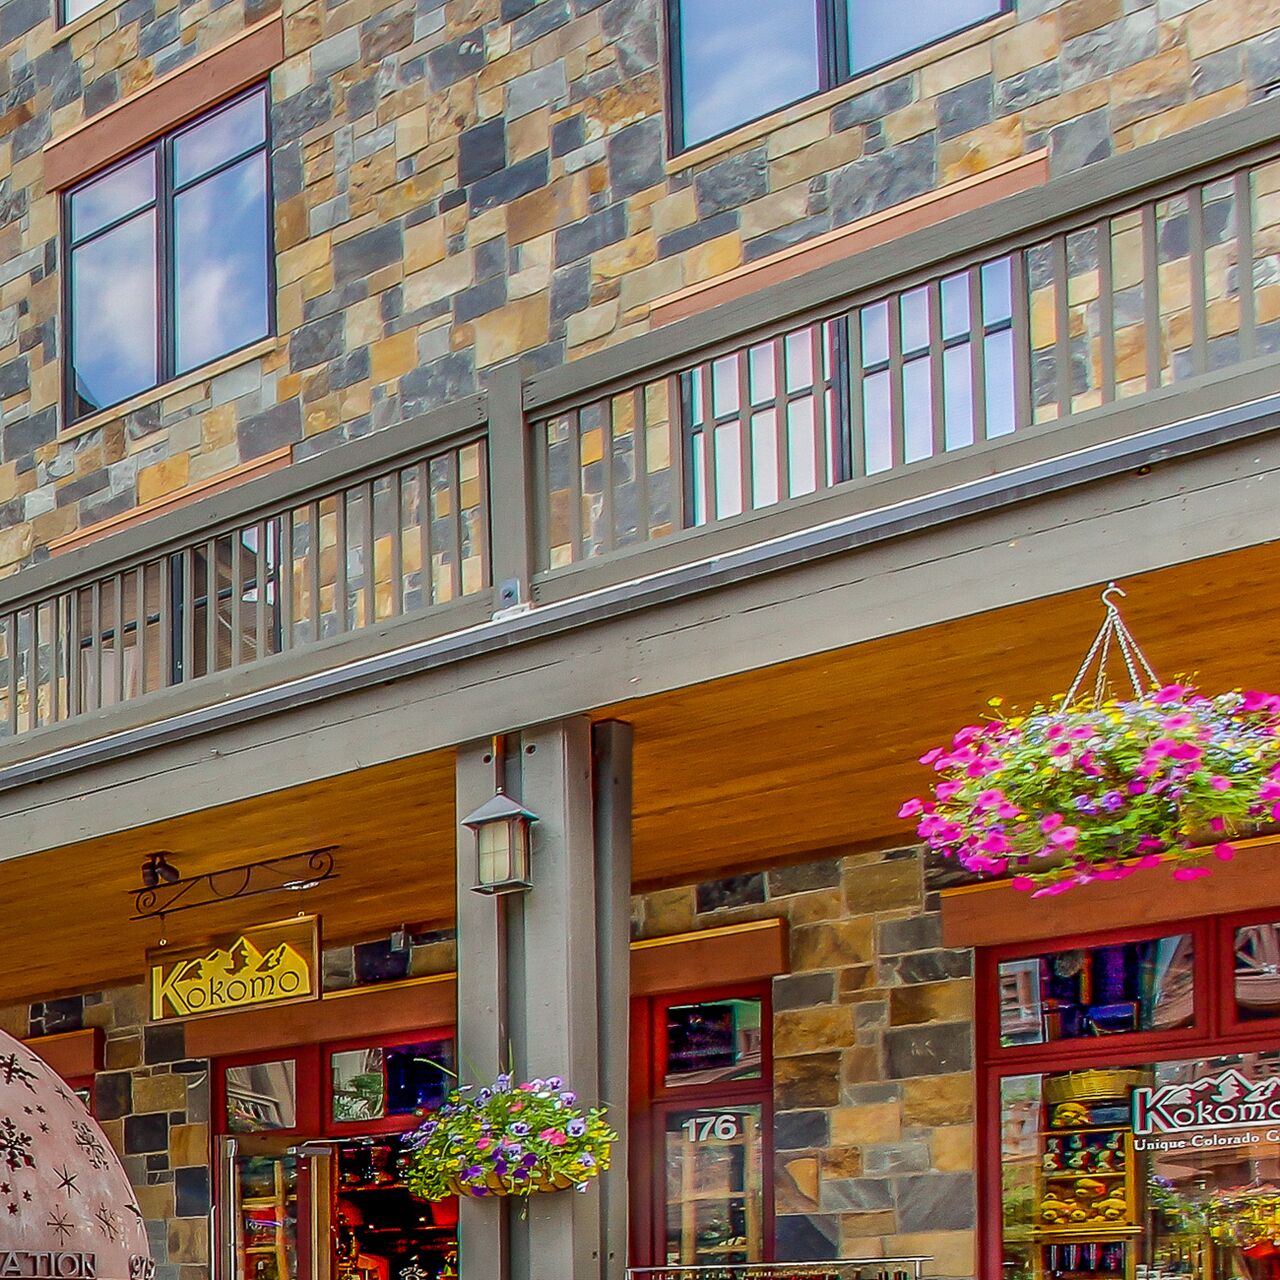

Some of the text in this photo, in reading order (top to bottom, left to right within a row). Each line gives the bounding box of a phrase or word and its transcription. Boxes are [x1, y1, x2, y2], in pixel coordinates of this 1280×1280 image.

[151, 959, 300, 1021] Kokomo
[681, 1114, 738, 1143] 176
[1133, 1139, 1187, 1152] Unique
[1191, 1132, 1260, 1148] Colorado
